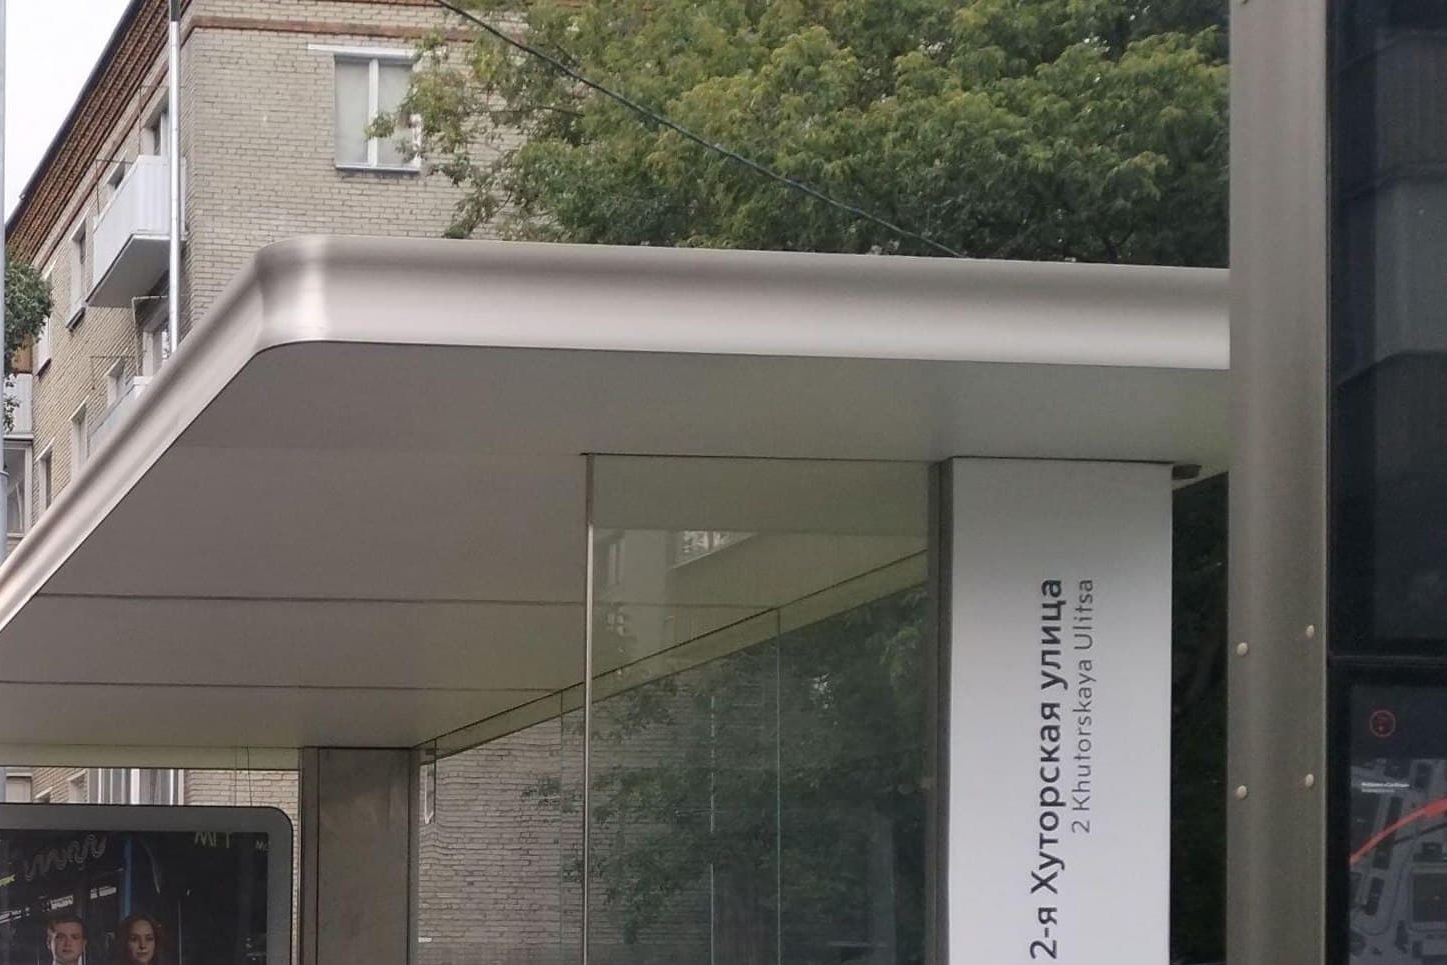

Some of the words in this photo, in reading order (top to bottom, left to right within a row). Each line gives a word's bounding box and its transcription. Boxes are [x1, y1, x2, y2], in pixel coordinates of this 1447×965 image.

[1040, 579, 1069, 690] улица
[1073, 579, 1094, 651] Ulitsa
[1072, 659, 1097, 812] Khutorskaya
[1030, 702, 1066, 895] Хуторская
[1071, 819, 1091, 834] 2
[1029, 906, 1059, 959] 2-я
